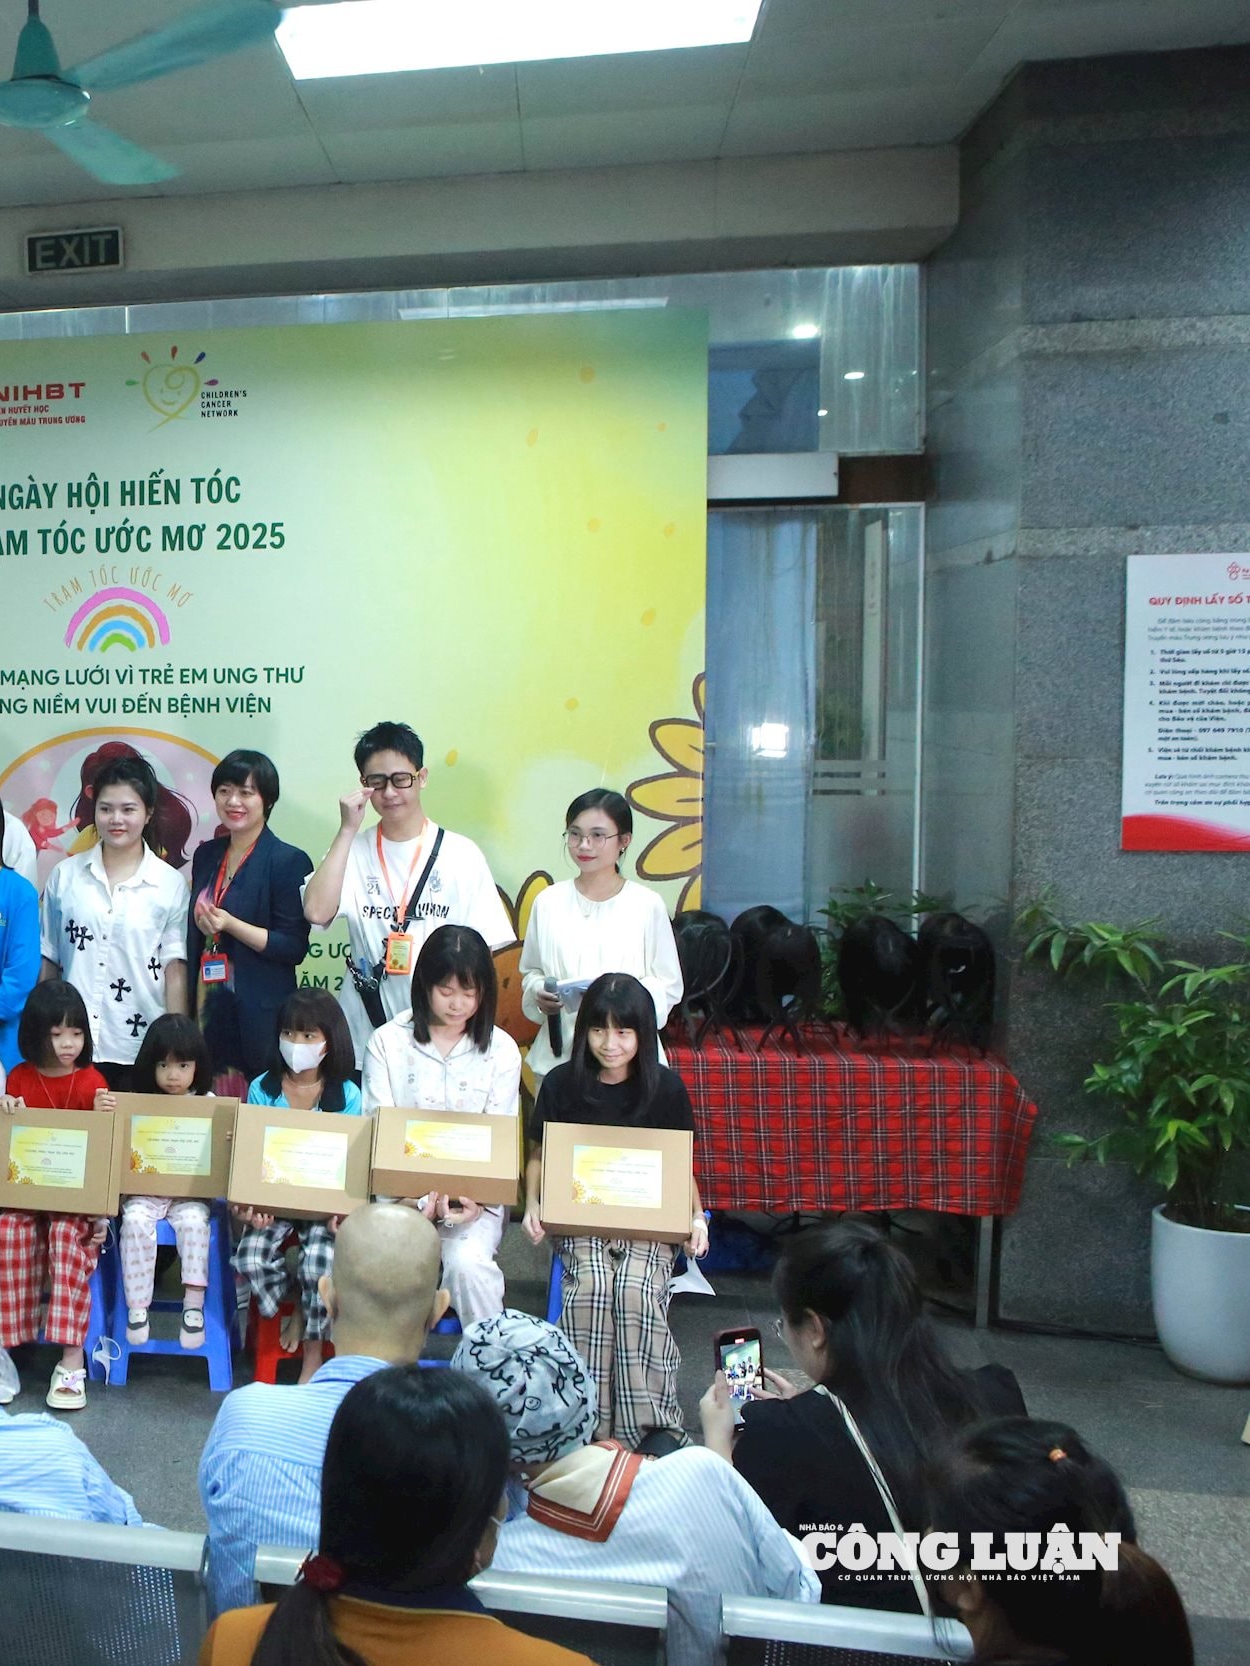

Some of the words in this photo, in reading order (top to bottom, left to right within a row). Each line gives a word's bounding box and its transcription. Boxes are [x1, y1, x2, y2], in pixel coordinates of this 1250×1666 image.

[35, 234, 112, 269] EXIT
[201, 390, 247, 399] CHILDREN'S
[201, 400, 231, 408] CANCER
[38, 416, 63, 425] TRUNG
[201, 409, 239, 418] NETWORK
[68, 472, 109, 515] HỘI
[121, 468, 180, 506] HIẾN
[190, 468, 240, 504] TÓC
[37, 520, 85, 555] TÓC
[96, 519, 151, 553] ƯỚC
[162, 523, 206, 551] MƠ
[216, 522, 285, 550] 2025
[89, 564, 118, 588] TÓC
[1149, 597, 1171, 605] QUY
[1228, 592, 1244, 604] SỐ
[0, 669, 60, 690] MẠNG
[66, 665, 109, 685] LƯỚI
[115, 664, 134, 684] VÌ
[138, 663, 174, 684] TRẺ
[180, 668, 207, 684] EM
[214, 668, 257, 684] UNG
[263, 666, 305, 683] THƯ
[33, 693, 79, 714] NIỀM
[85, 698, 116, 714] VUI
[122, 692, 161, 713] ĐẾN
[168, 693, 220, 718] BỆNH
[225, 693, 270, 718] VIỆN
